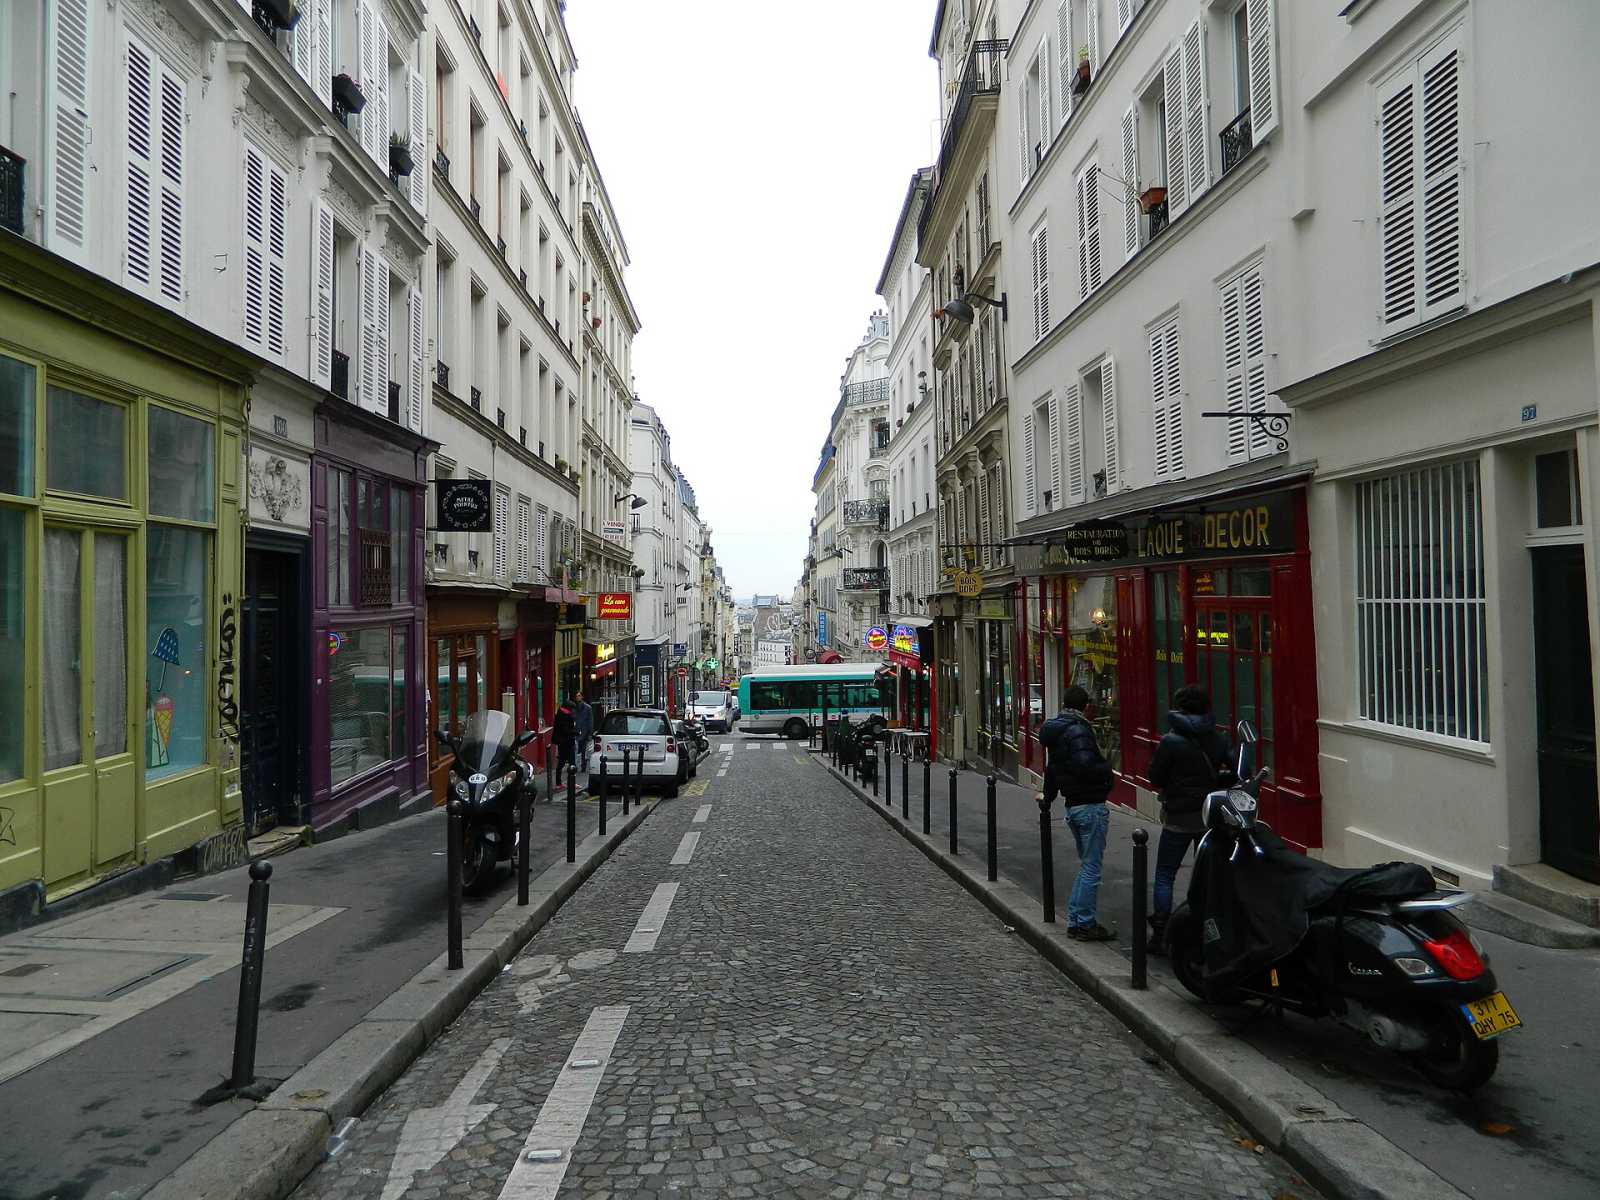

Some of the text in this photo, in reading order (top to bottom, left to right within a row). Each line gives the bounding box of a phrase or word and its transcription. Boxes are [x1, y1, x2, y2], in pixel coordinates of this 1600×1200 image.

[1066, 528, 1126, 539] RESTAURATION
[1137, 520, 1184, 558] LAQUE
[1497, 1010, 1516, 1026] 75
